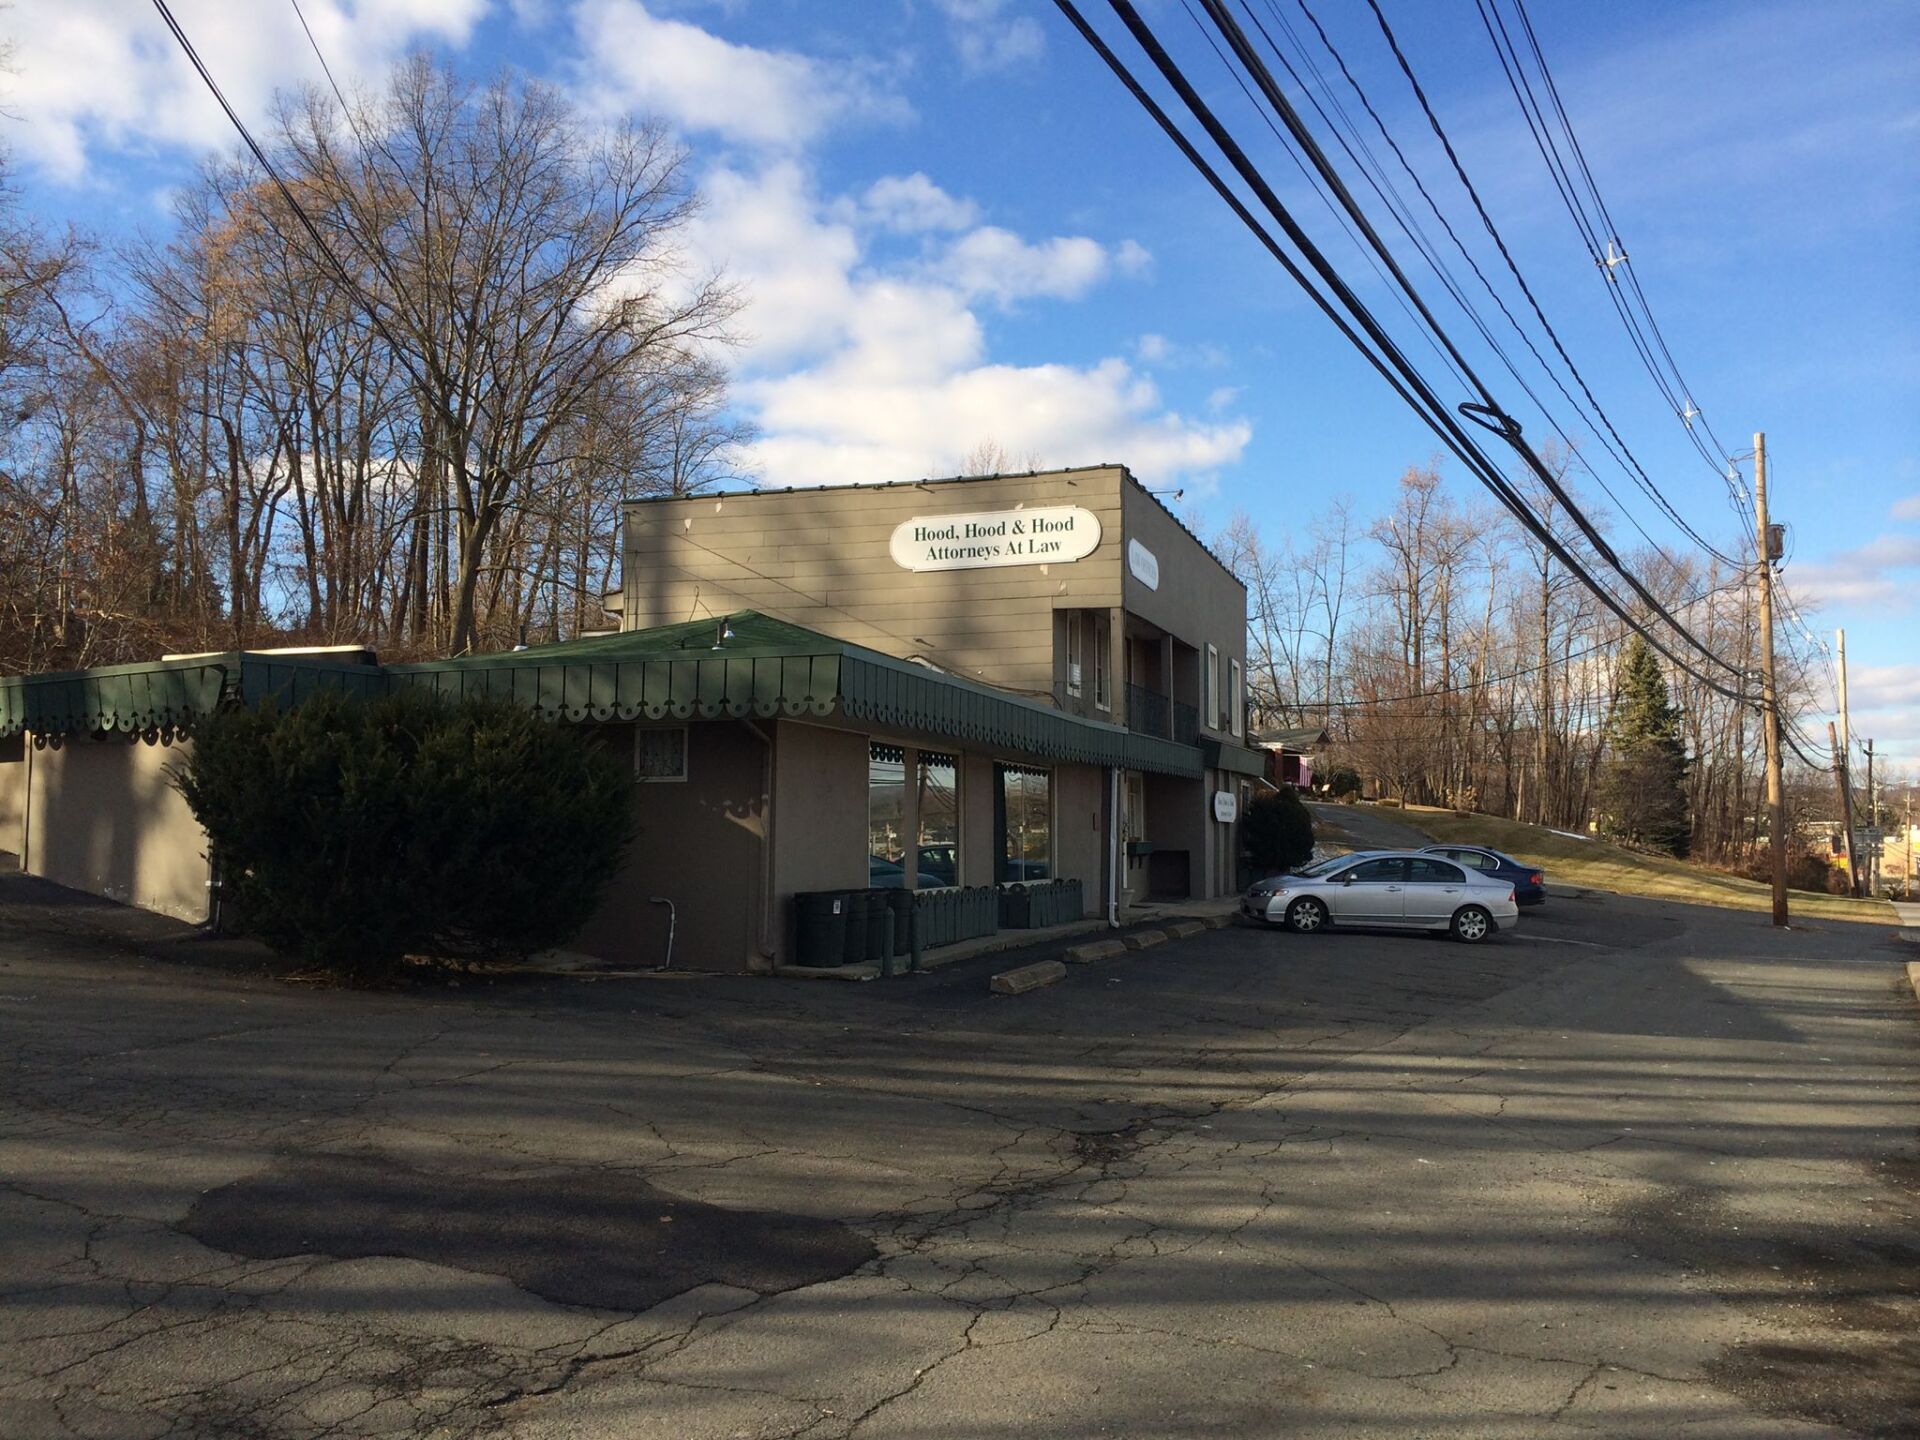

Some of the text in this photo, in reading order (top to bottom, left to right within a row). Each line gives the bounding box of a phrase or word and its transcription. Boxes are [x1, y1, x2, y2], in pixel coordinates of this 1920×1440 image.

[914, 516, 1074, 541] Hood, Hood & Hood
[926, 539, 1062, 561] Attorneys At Law
